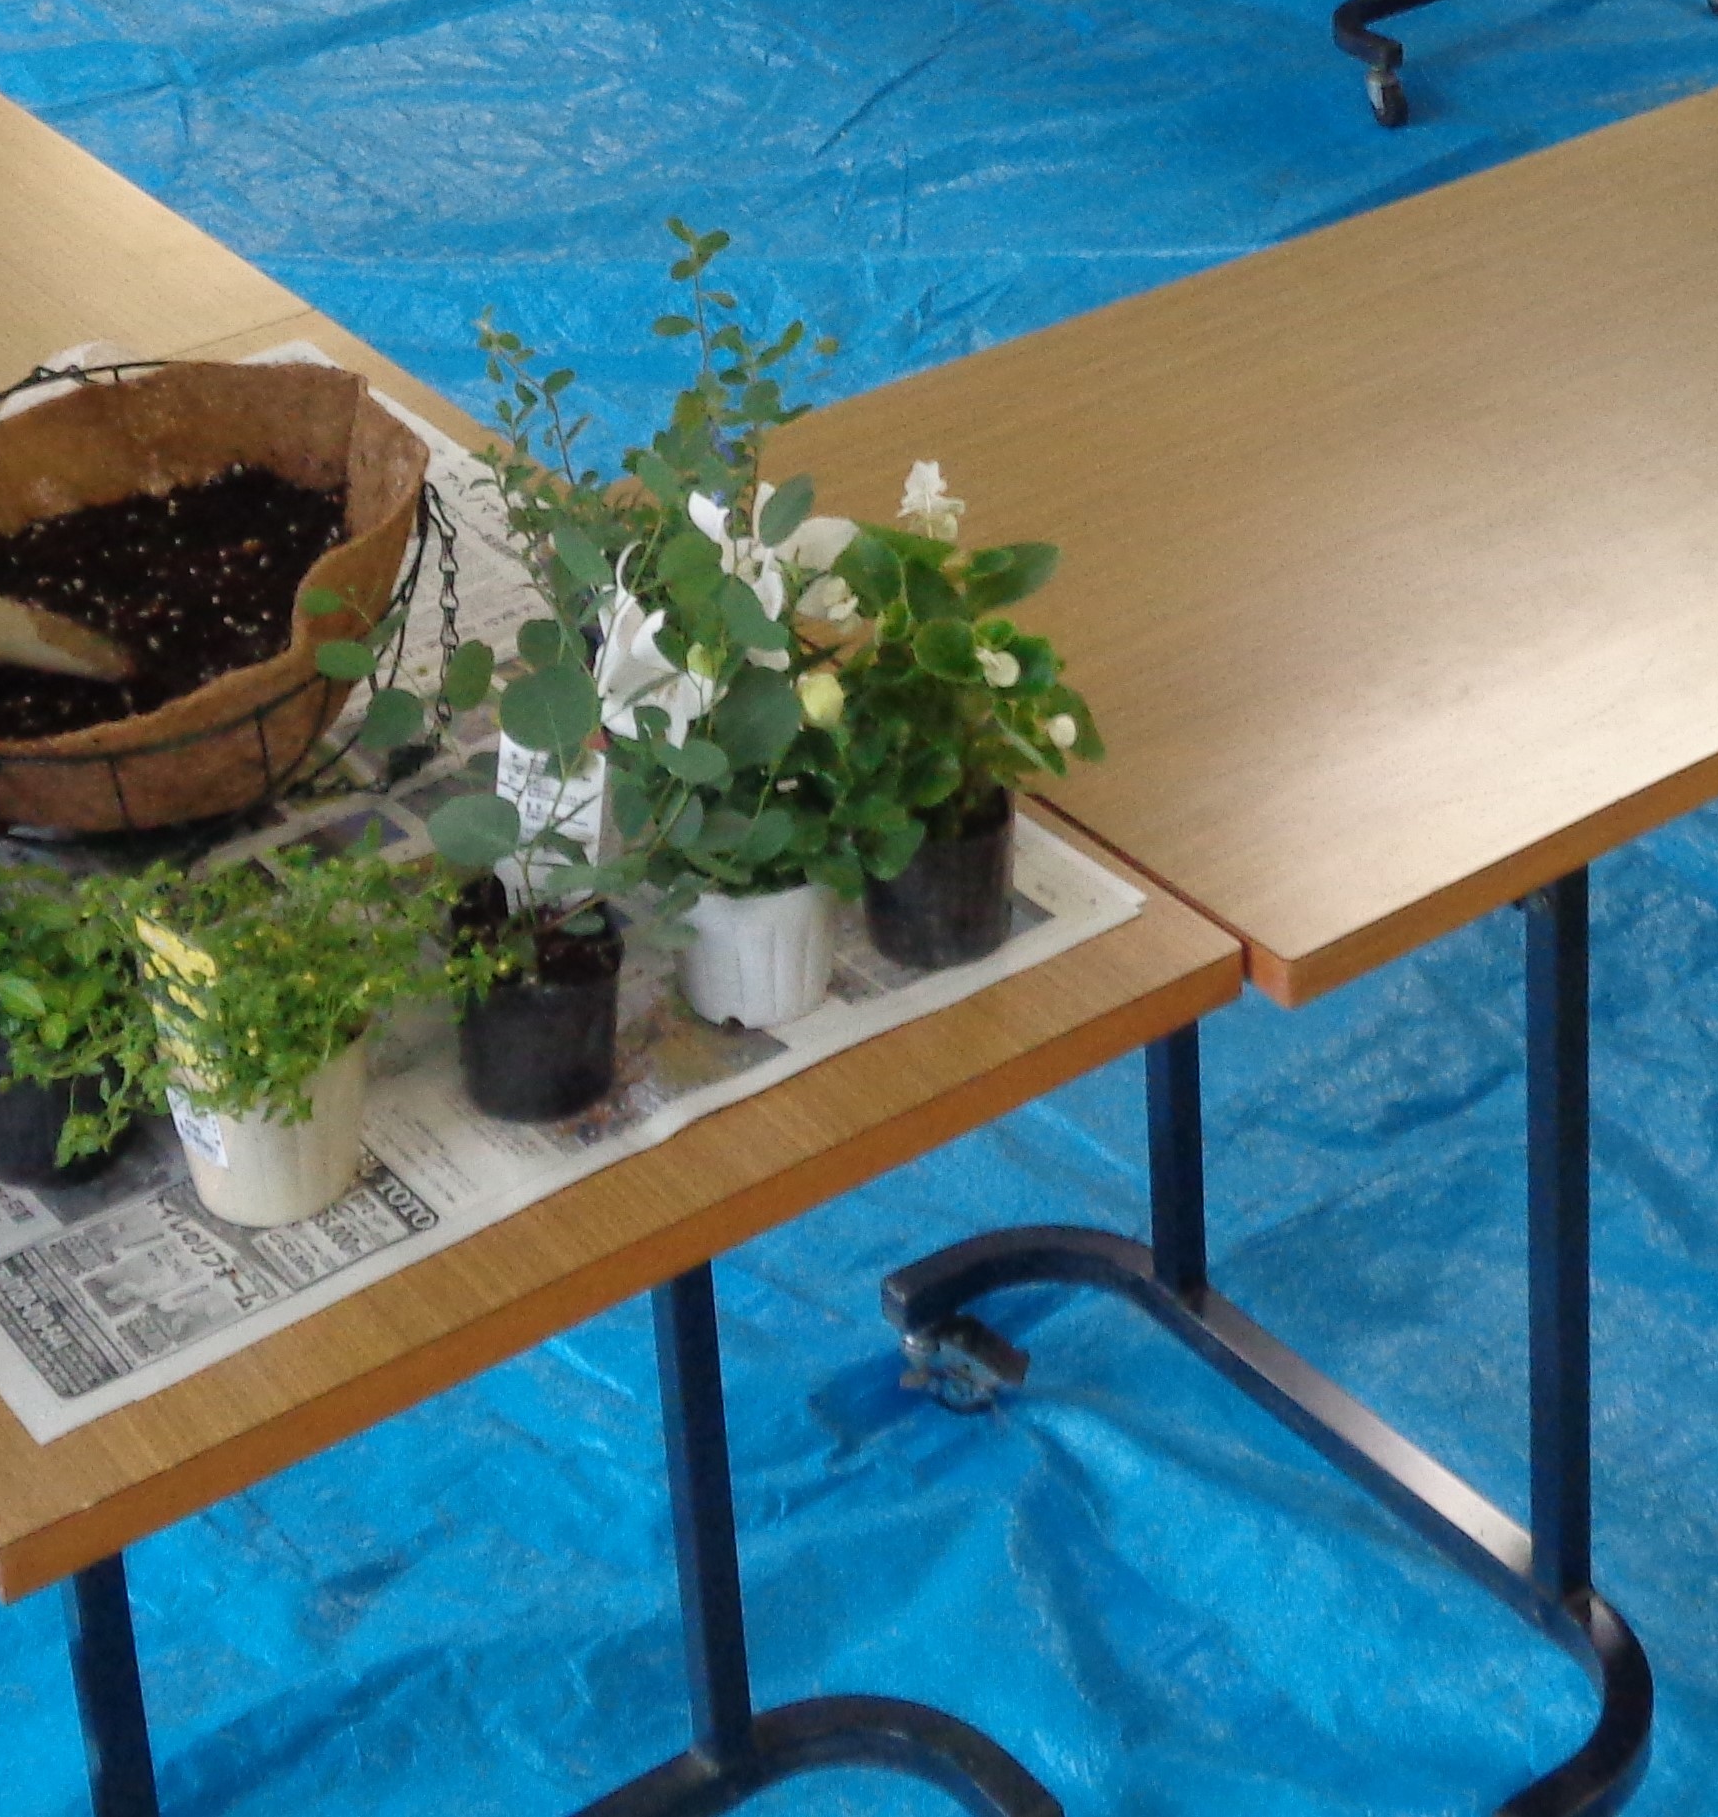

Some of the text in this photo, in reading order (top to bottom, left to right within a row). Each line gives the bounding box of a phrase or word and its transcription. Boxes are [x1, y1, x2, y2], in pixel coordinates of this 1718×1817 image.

[379, 1184, 439, 1231] TOTO
[146, 1194, 260, 1311] トイレのリフォーム
